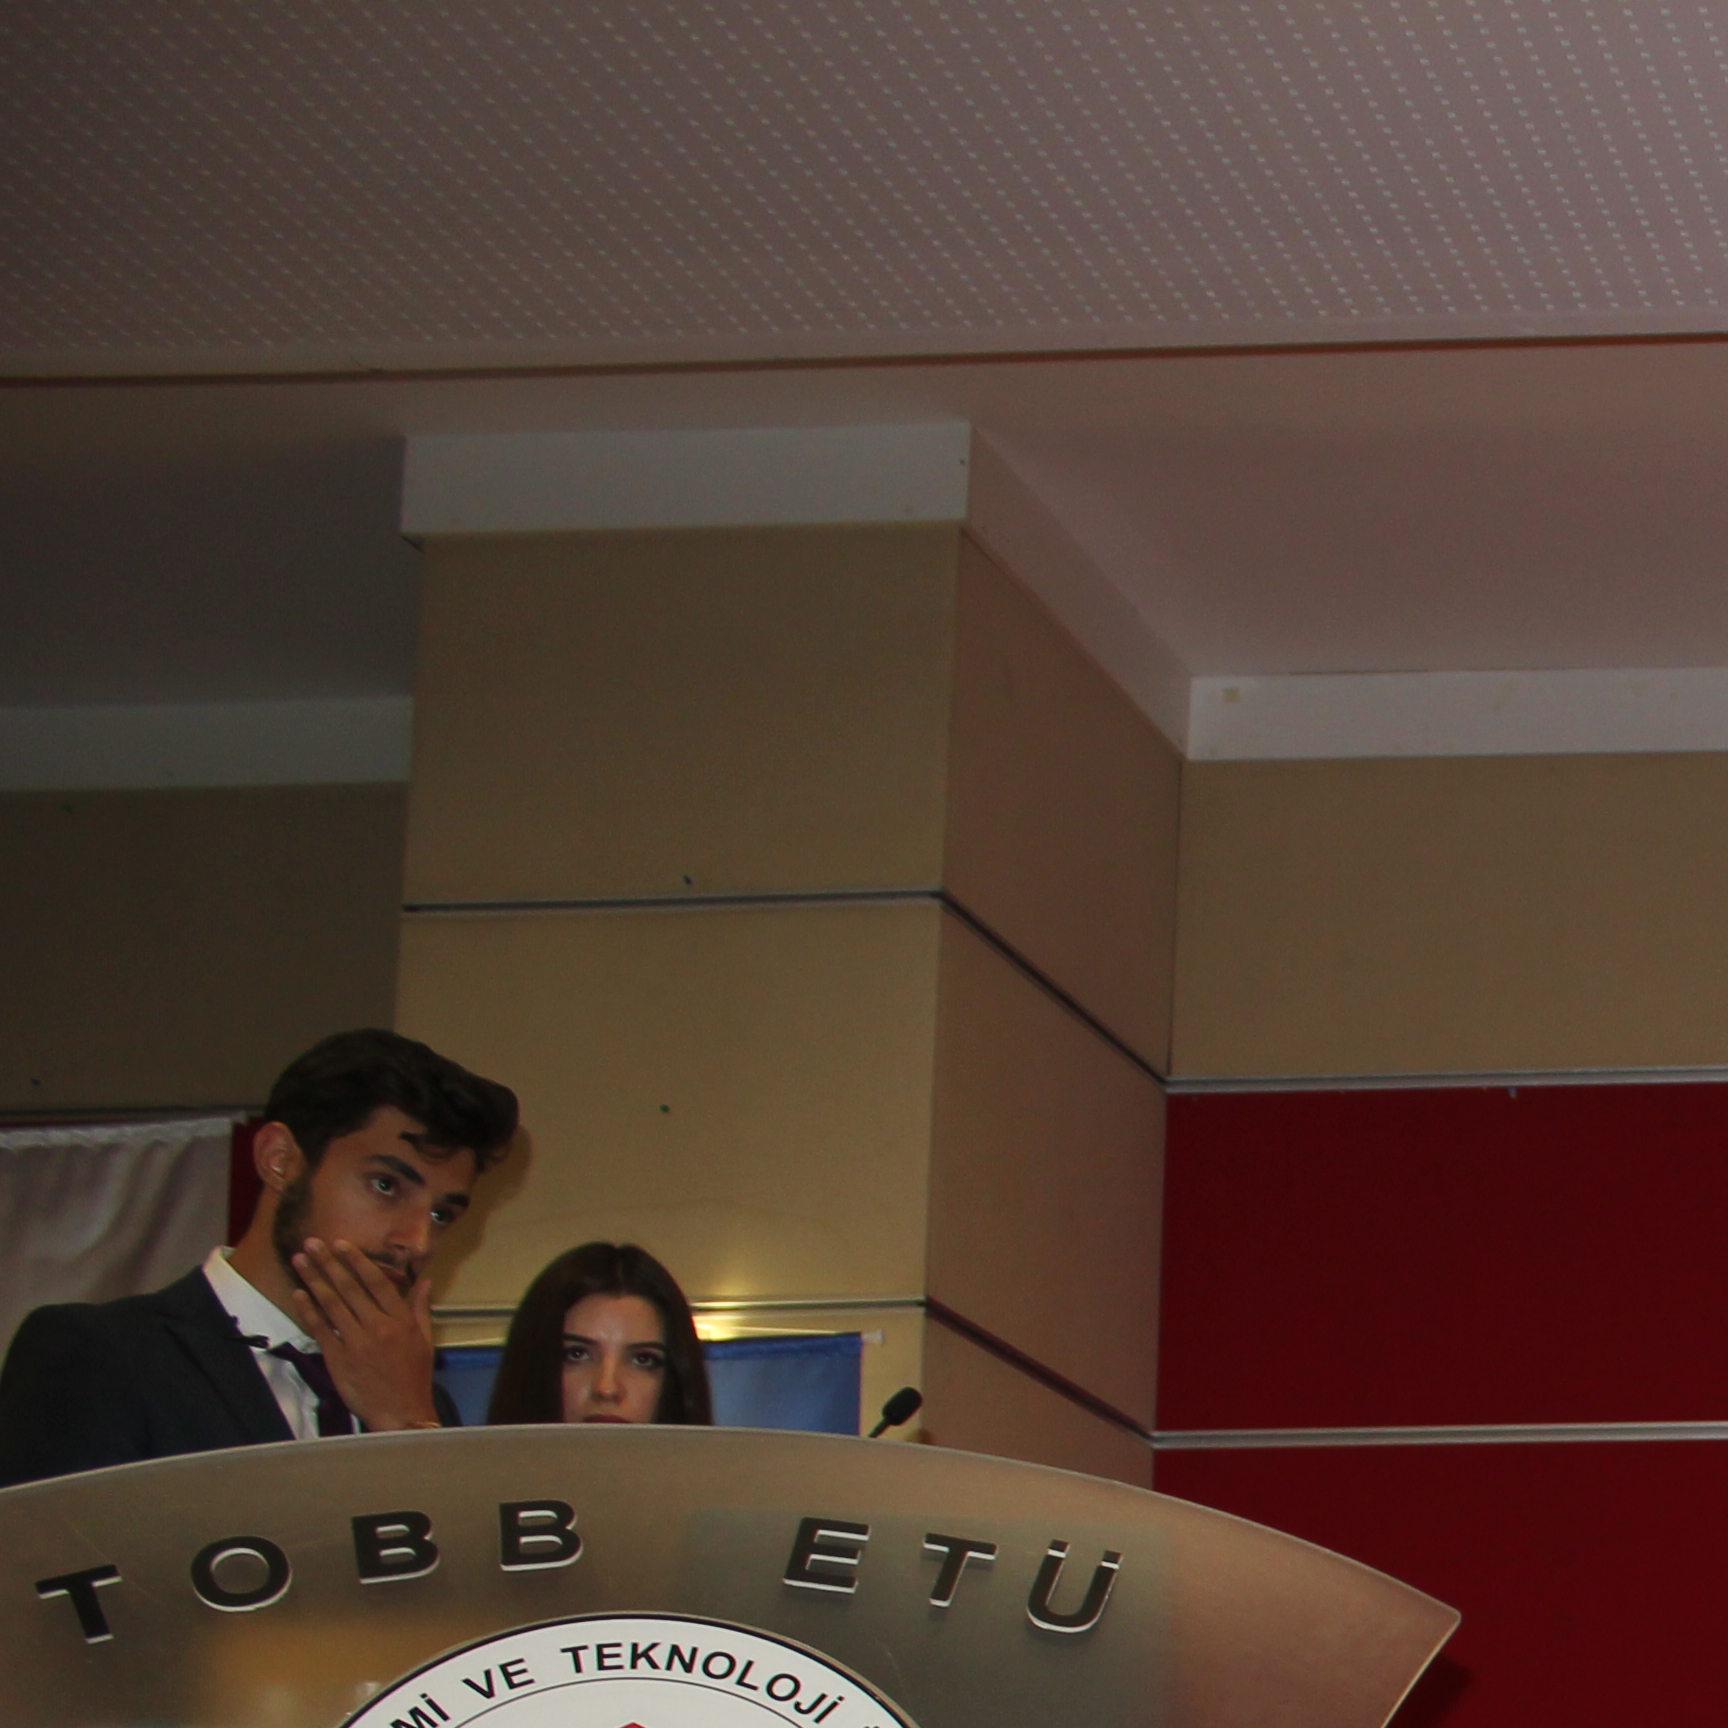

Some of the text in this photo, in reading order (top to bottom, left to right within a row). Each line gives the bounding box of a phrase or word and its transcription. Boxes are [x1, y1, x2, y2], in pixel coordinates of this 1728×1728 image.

[36, 1497, 1123, 1644] TOBB ETÜ
[462, 1658, 535, 1699] VE
[560, 1642, 844, 1724] TEKNOLOJİ
